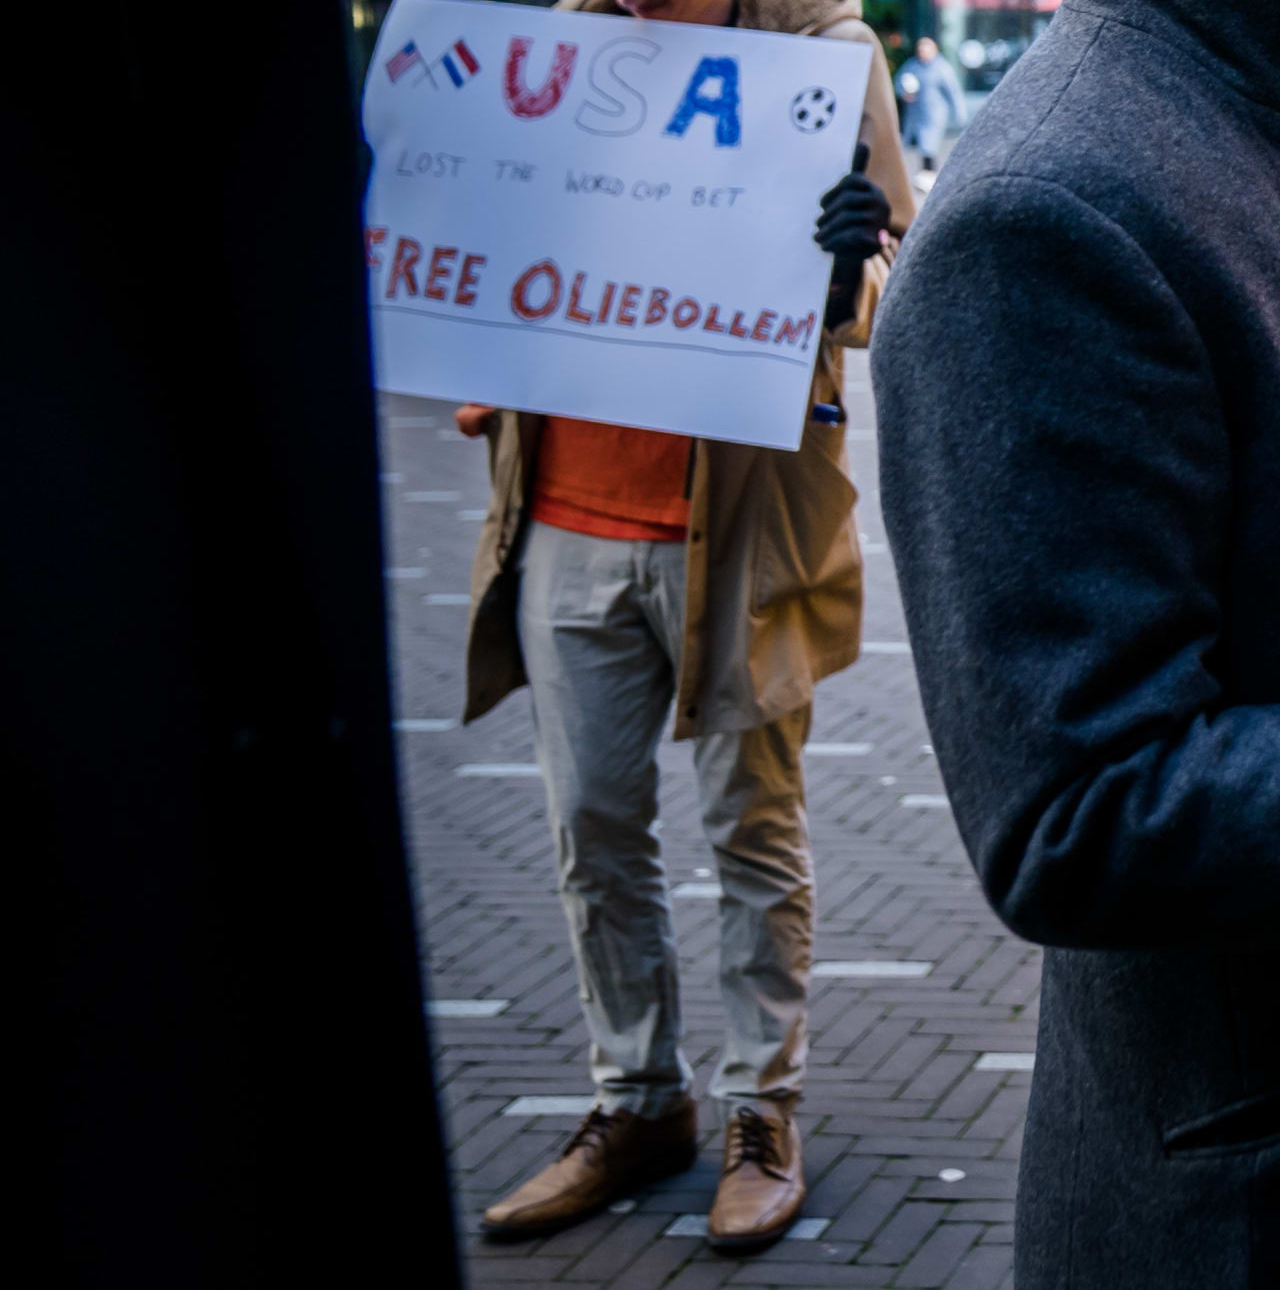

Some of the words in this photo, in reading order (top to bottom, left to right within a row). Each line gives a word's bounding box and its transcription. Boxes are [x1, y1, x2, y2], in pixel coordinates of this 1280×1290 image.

[503, 35, 743, 150] USA
[395, 149, 466, 179] LOST
[495, 159, 537, 183] THE
[631, 180, 672, 202] CUP
[690, 185, 745, 207] BET
[364, 226, 488, 307] FREE
[510, 257, 817, 351] OLIEBOLLEN!
